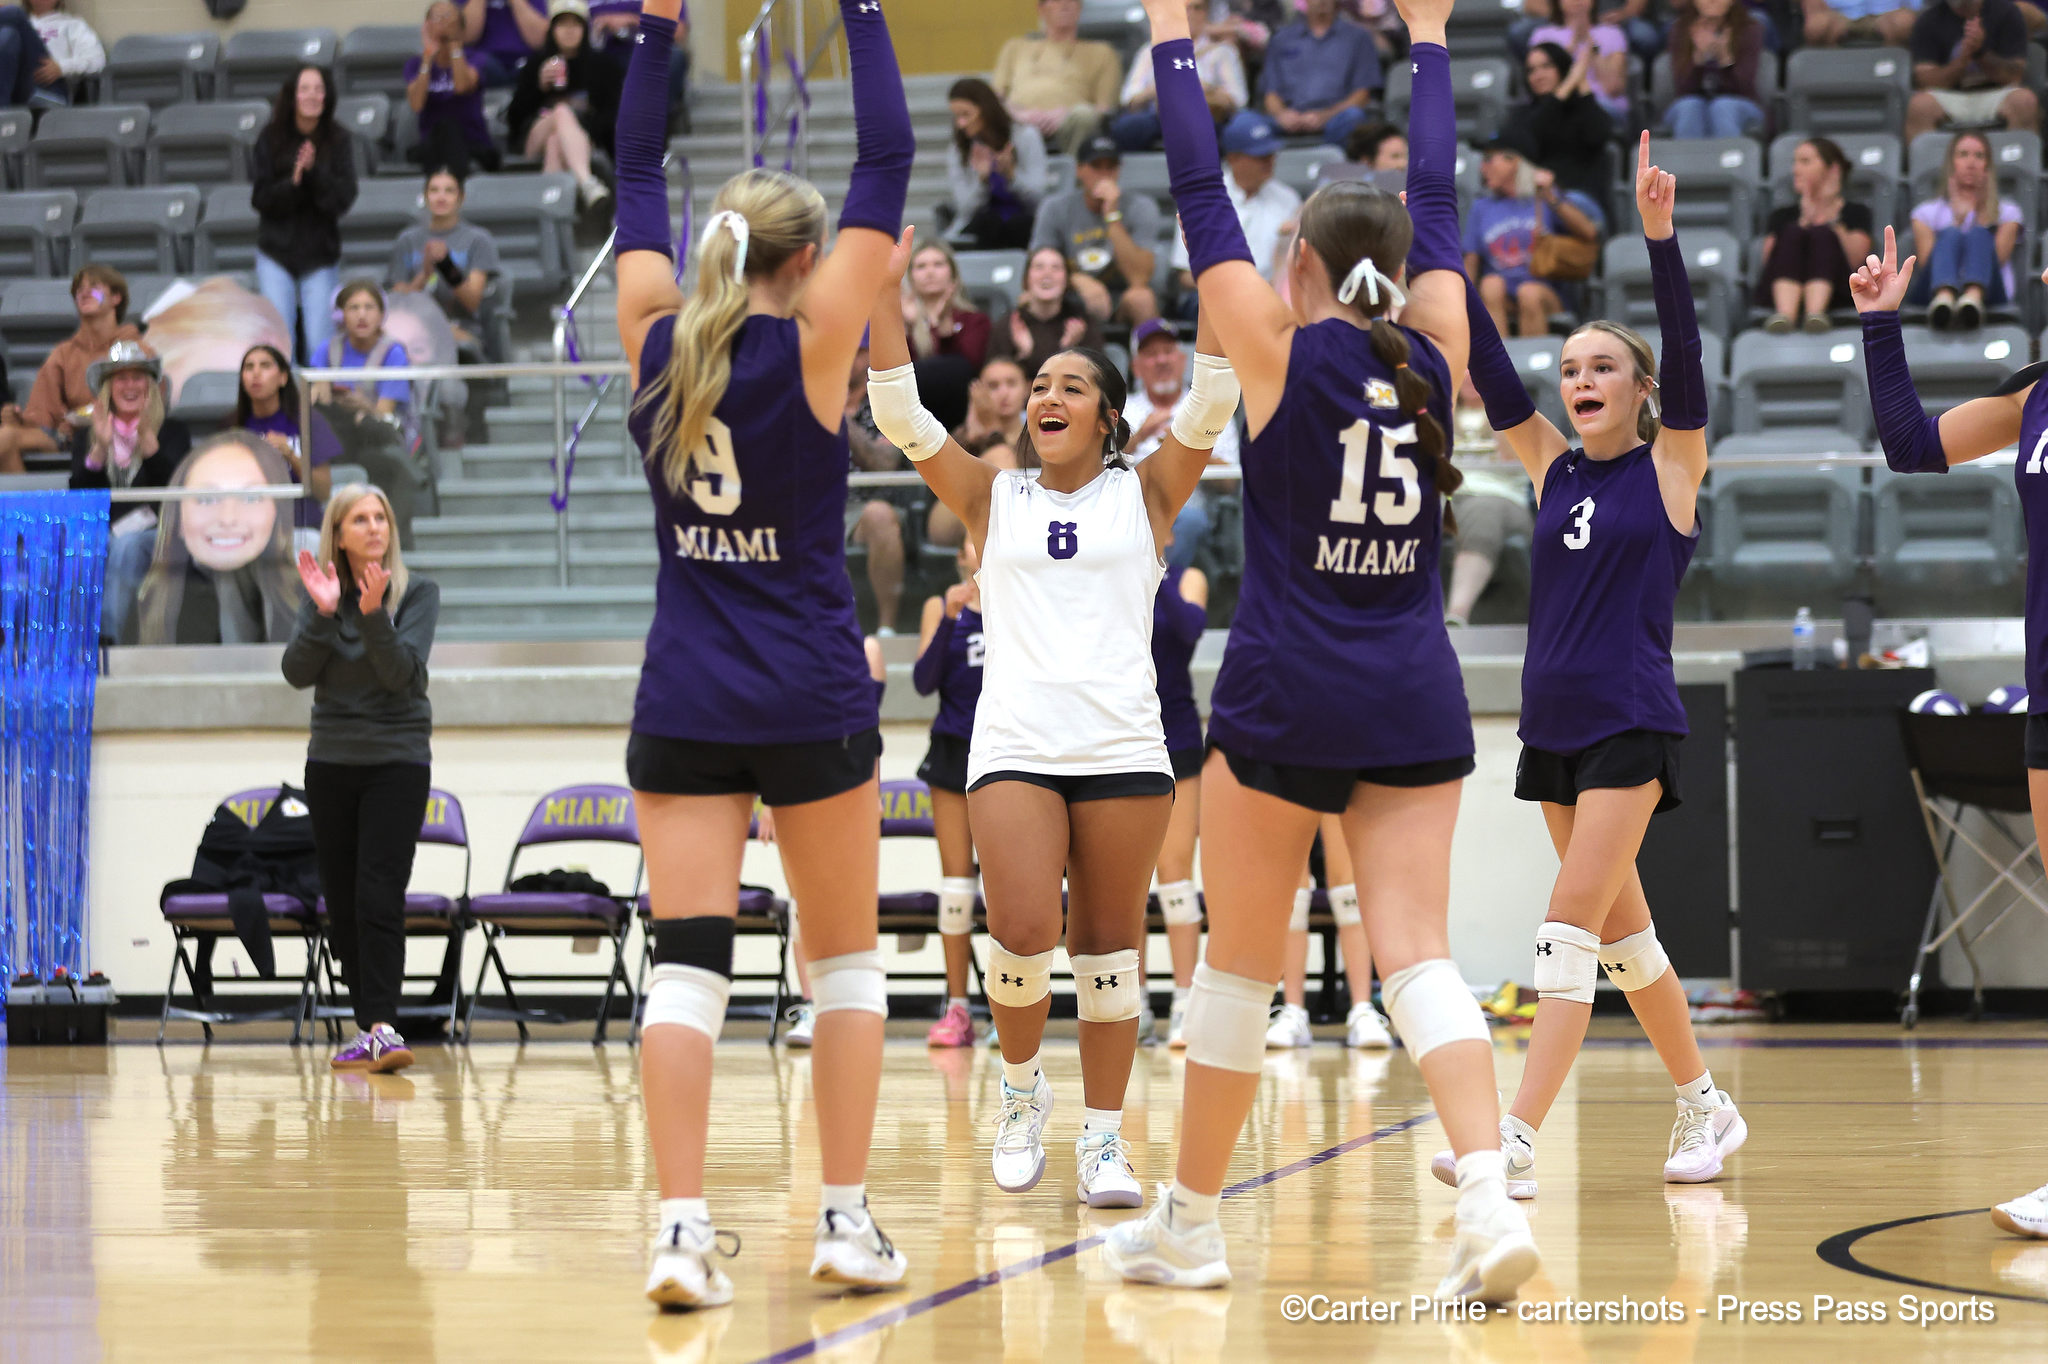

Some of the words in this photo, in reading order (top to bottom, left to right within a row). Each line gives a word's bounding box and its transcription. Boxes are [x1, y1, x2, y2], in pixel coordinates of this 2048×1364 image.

[690, 416, 742, 516] 9
[1328, 418, 1423, 526] 15
[673, 523, 781, 563] MIAMI
[1047, 520, 1078, 560] 8
[1563, 496, 1596, 550] 3
[1313, 535, 1420, 575] MIAMI
[543, 797, 630, 825] MIAMI
